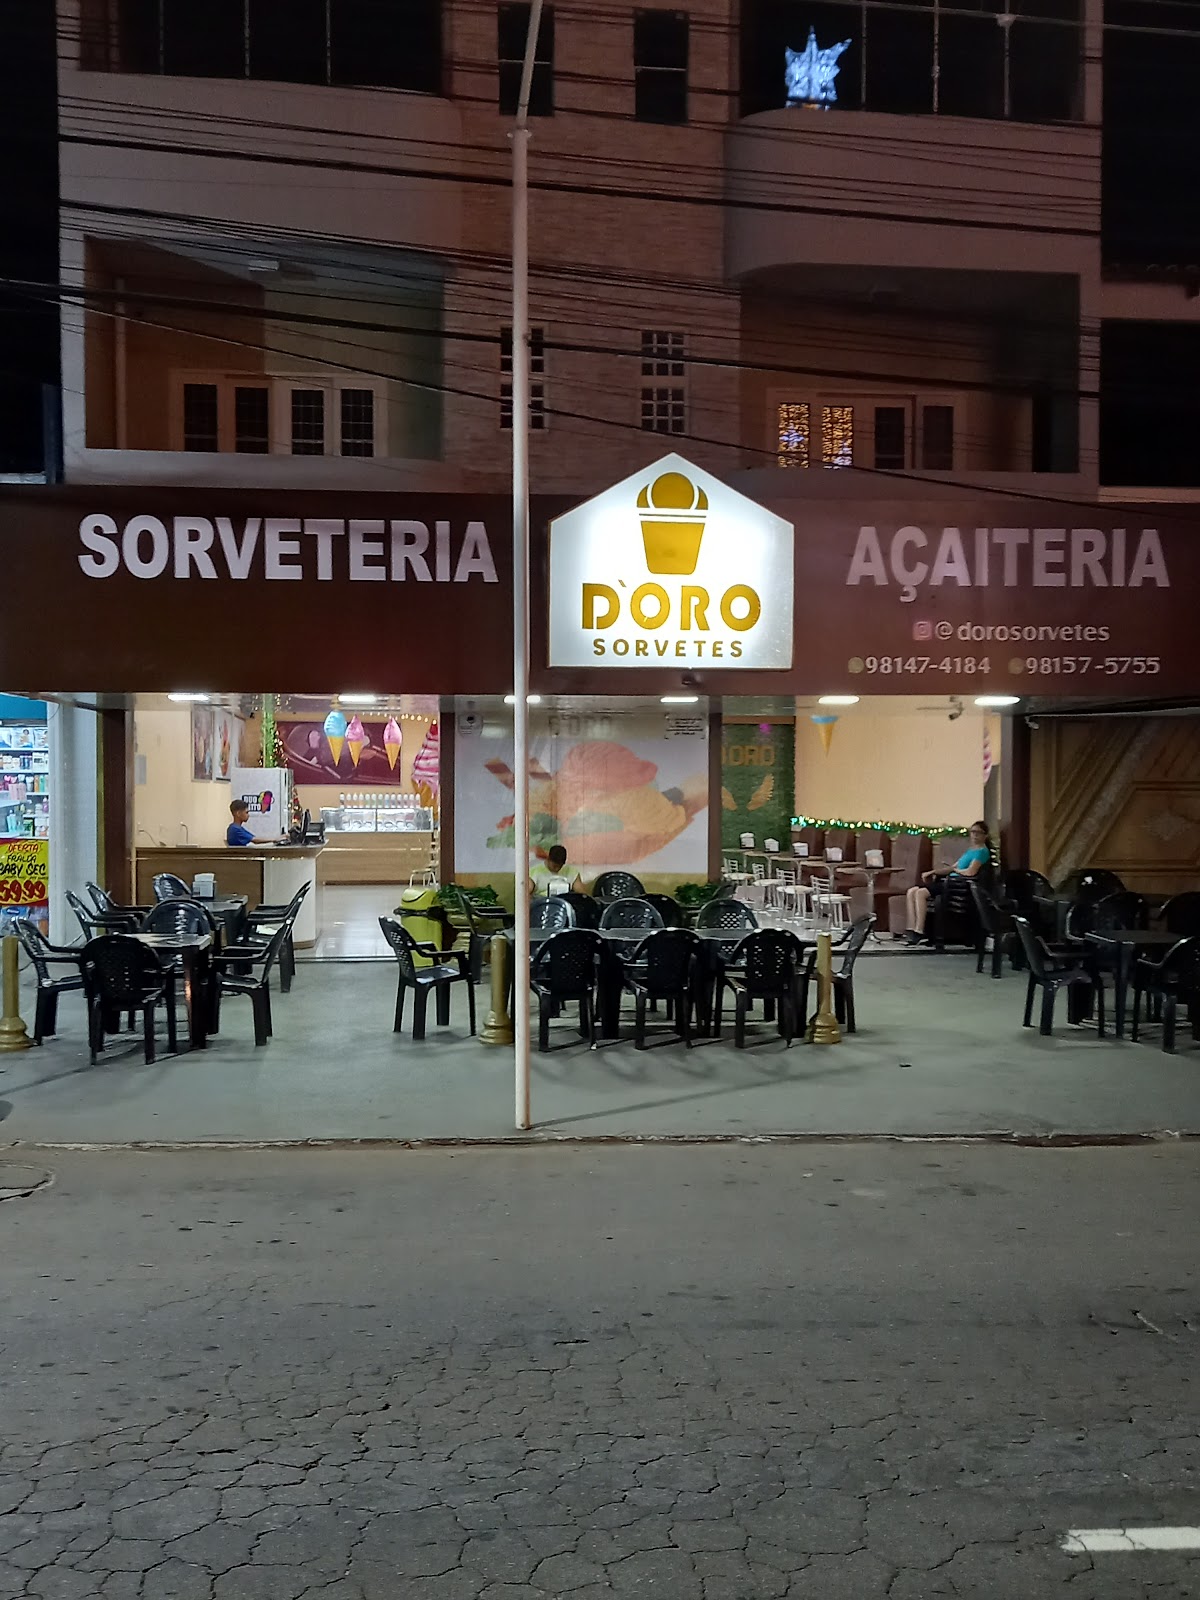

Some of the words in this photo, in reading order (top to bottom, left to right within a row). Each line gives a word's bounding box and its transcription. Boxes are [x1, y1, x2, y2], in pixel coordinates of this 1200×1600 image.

[77, 513, 499, 583] SORVETERIA
[846, 526, 1170, 602] AÇAITERIA
[593, 638, 743, 658] SORVETES
[865, 656, 992, 675] 98147-4184
[1025, 656, 1161, 675] 98157-5755
[8, 843, 39, 853] OFERTA
[26, 862, 46, 875] SEC
